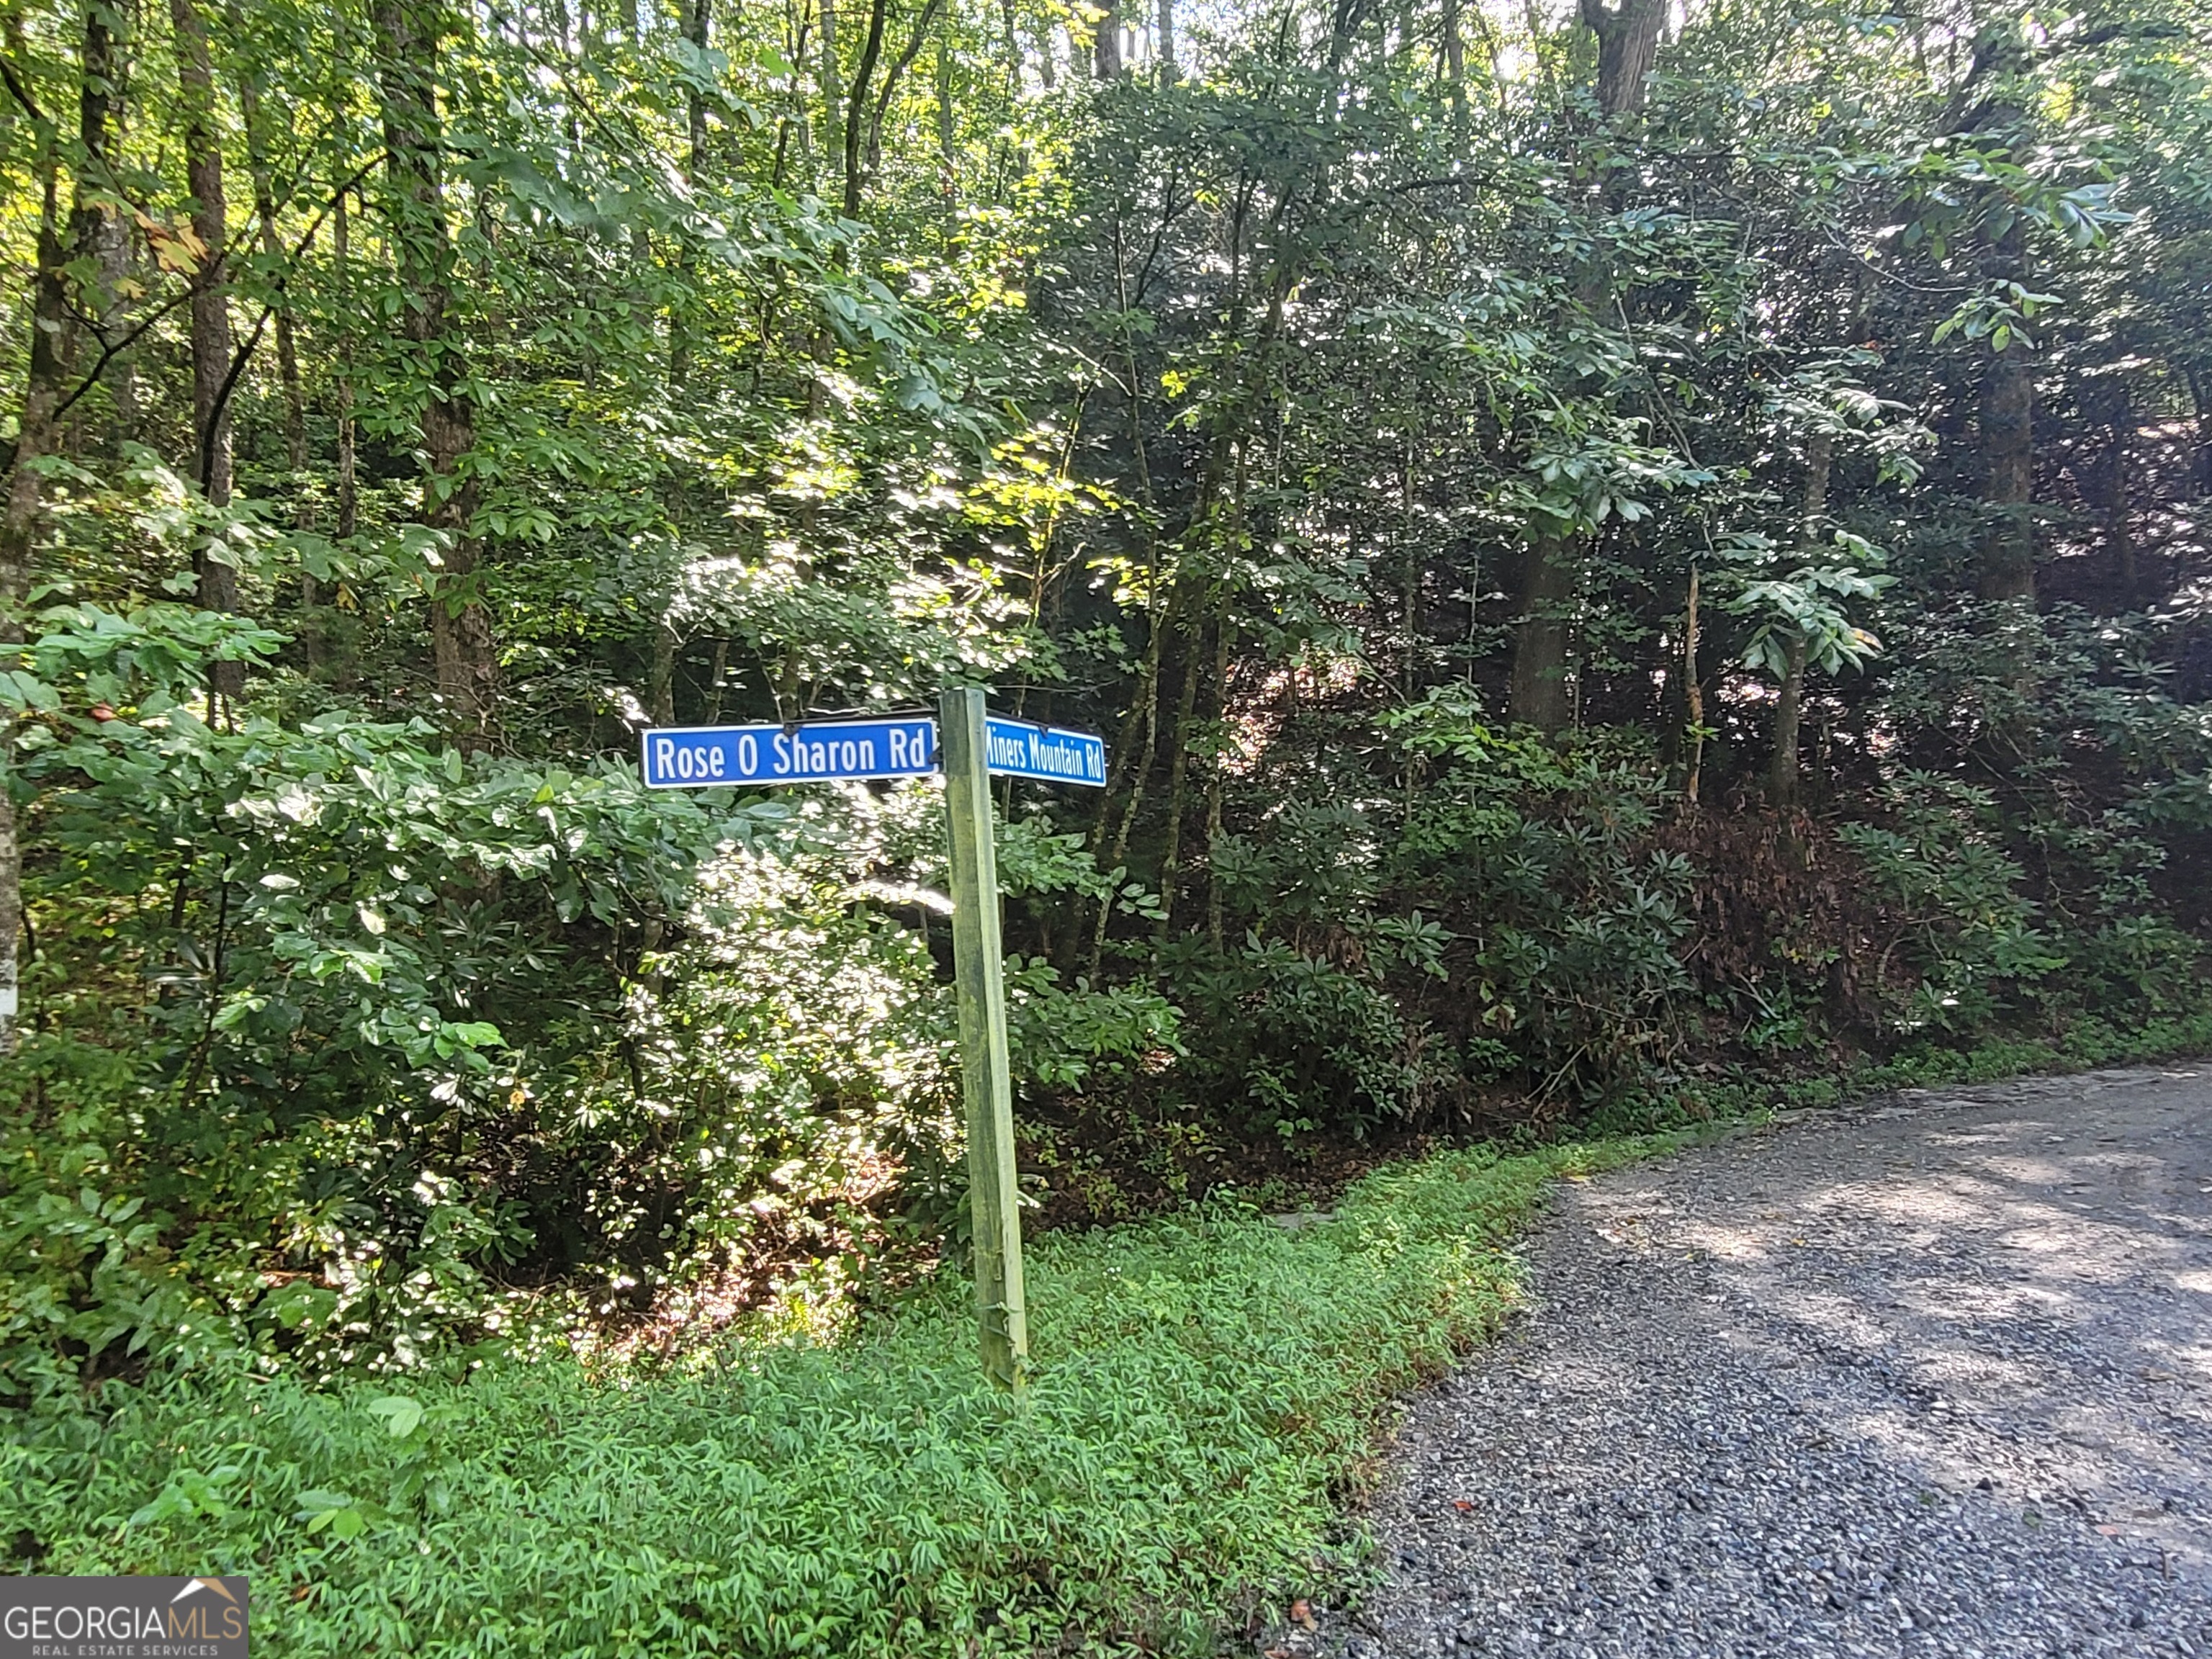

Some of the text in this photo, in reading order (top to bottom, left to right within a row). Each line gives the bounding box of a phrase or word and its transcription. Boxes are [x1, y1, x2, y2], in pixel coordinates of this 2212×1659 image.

[656, 727, 926, 779] Rose O Sharon Rd
[1028, 732, 1084, 776] Mountain
[1085, 742, 1102, 779] Rd
